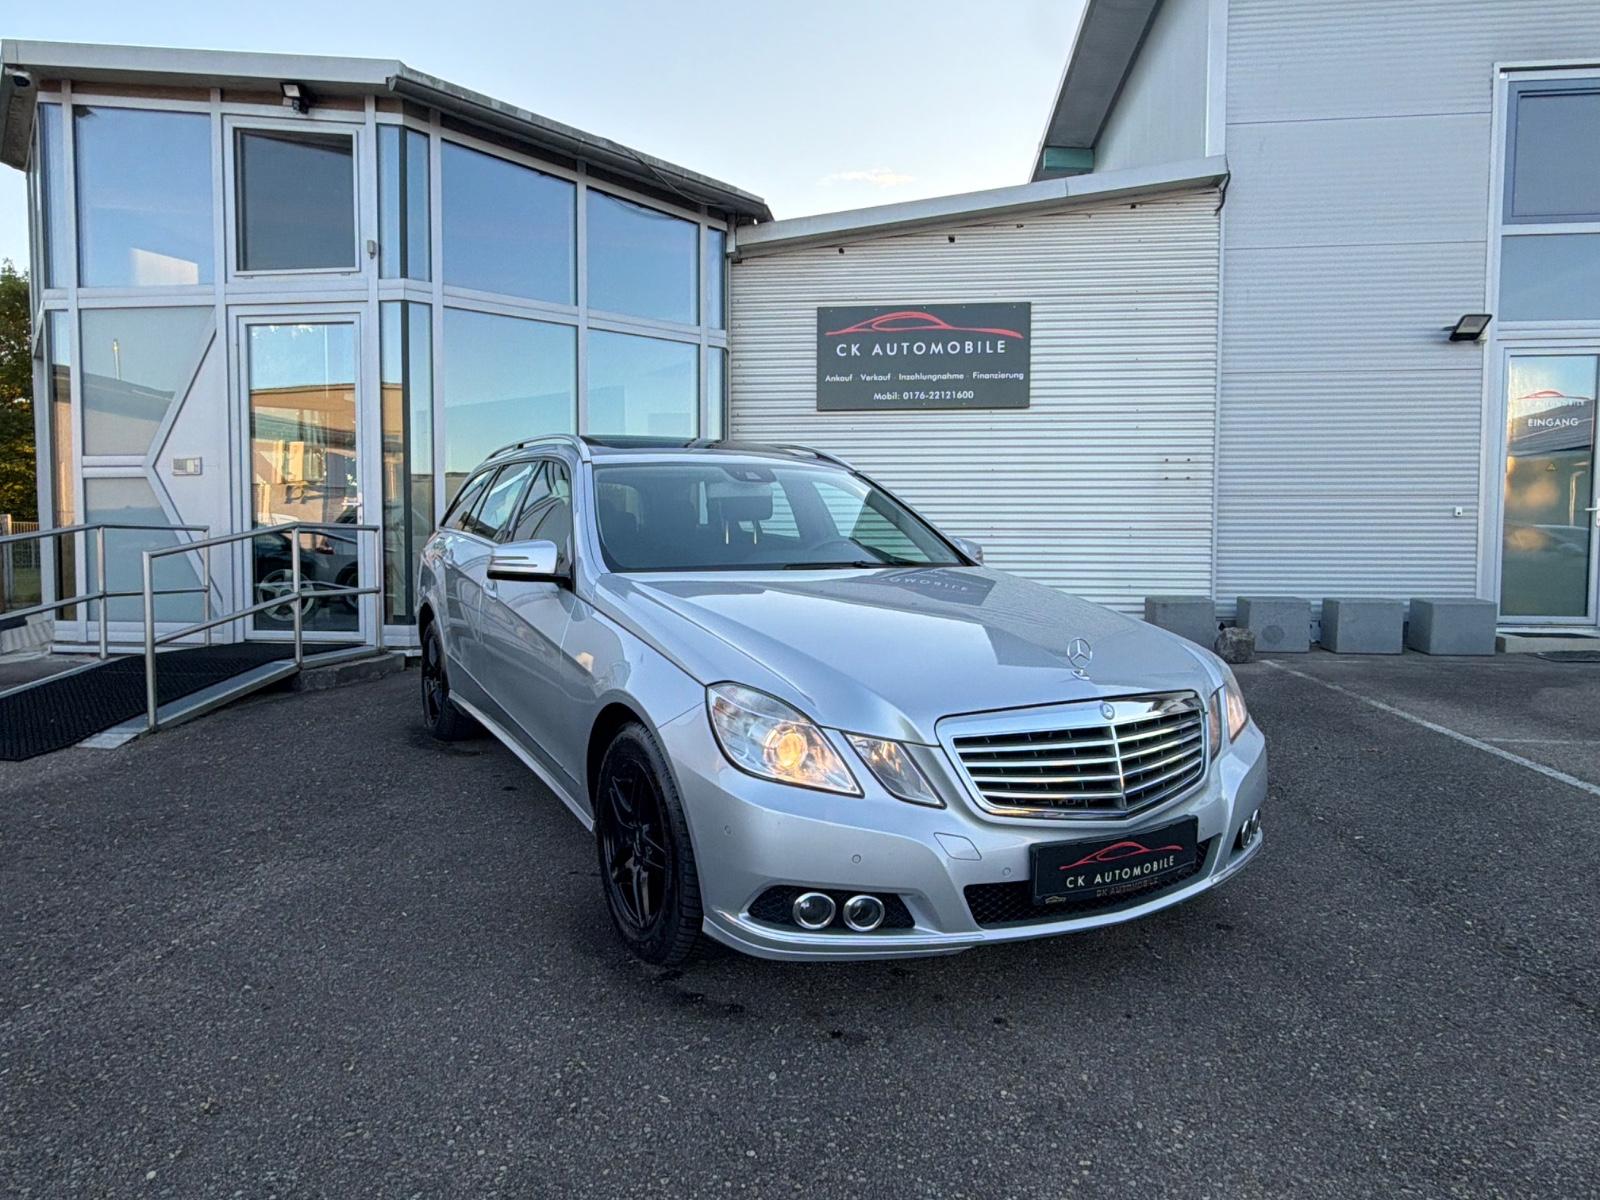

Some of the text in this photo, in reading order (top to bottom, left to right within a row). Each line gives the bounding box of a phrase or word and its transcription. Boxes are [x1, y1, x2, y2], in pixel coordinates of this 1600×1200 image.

[836, 340, 1006, 357] CK AUTOMOBILE
[825, 371, 1024, 382] Ankauf Verkauf Inzahlungnahme Finanzierung
[873, 390, 974, 400] Mobil: 0176-22121600
[1527, 417, 1578, 427] EINGANG
[1066, 855, 1175, 888] CK AUTOMOBILE
